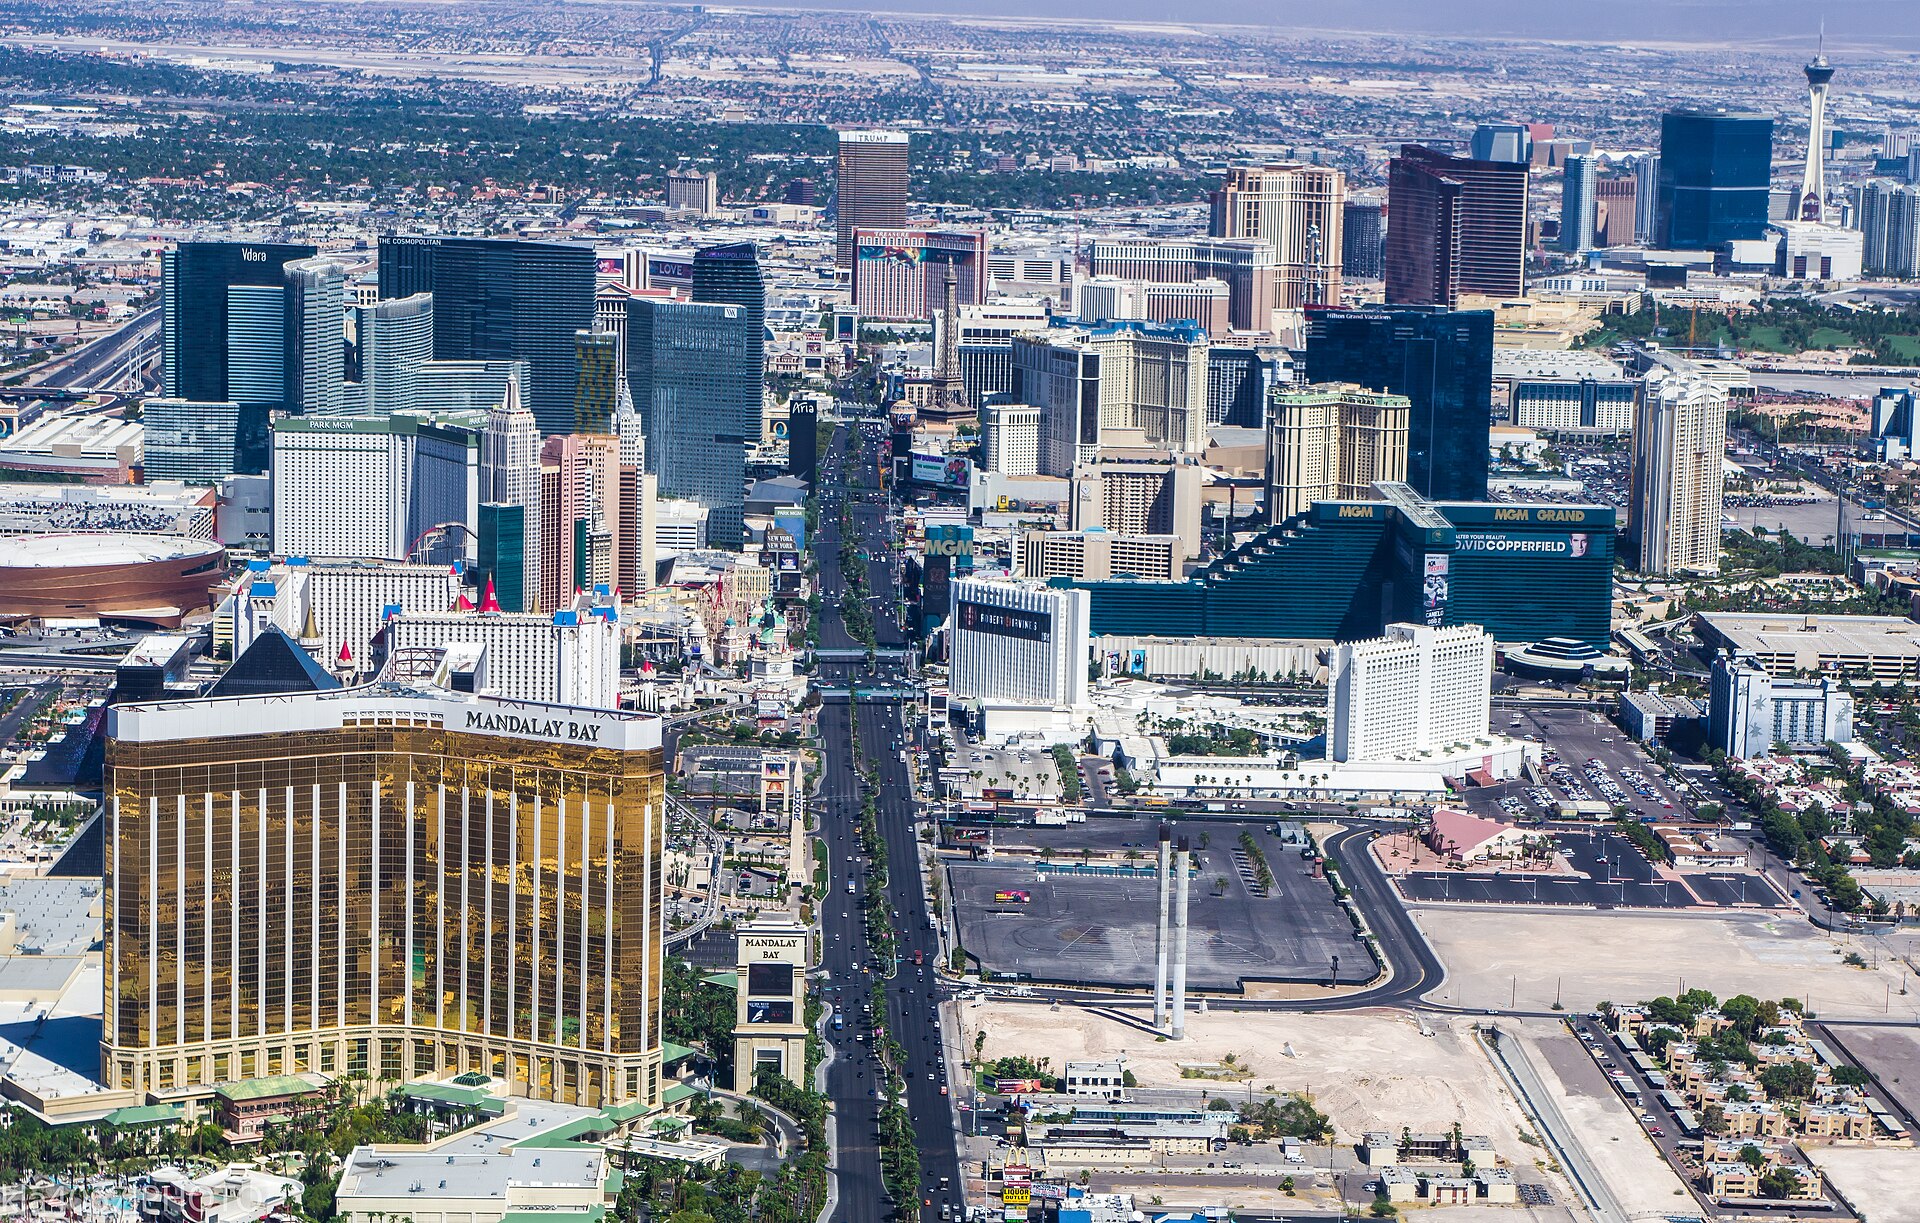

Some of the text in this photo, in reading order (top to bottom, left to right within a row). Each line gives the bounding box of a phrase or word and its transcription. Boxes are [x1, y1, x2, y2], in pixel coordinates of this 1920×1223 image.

[858, 134, 888, 142] TRUMP
[378, 237, 442, 246] THE COSMOPOLITAN
[241, 247, 267, 262] Vdara
[705, 251, 754, 260] COSMOPOLITAN
[659, 263, 683, 276] LOVE
[792, 401, 815, 414] Aria
[309, 421, 354, 430] PARK MGM
[1338, 505, 1374, 518] MGM
[1494, 508, 1585, 521] MGM GRAND
[923, 539, 974, 556] MGM
[980, 613, 1004, 625] ROBERT
[756, 692, 788, 700] EXCALIBUR
[465, 710, 601, 743] MANDALAY BAY
[793, 786, 802, 821] LUXOR
[745, 938, 798, 948] MANDALAY
[762, 951, 780, 959] BAY
[1004, 1188, 1030, 1196] LIQUOR
